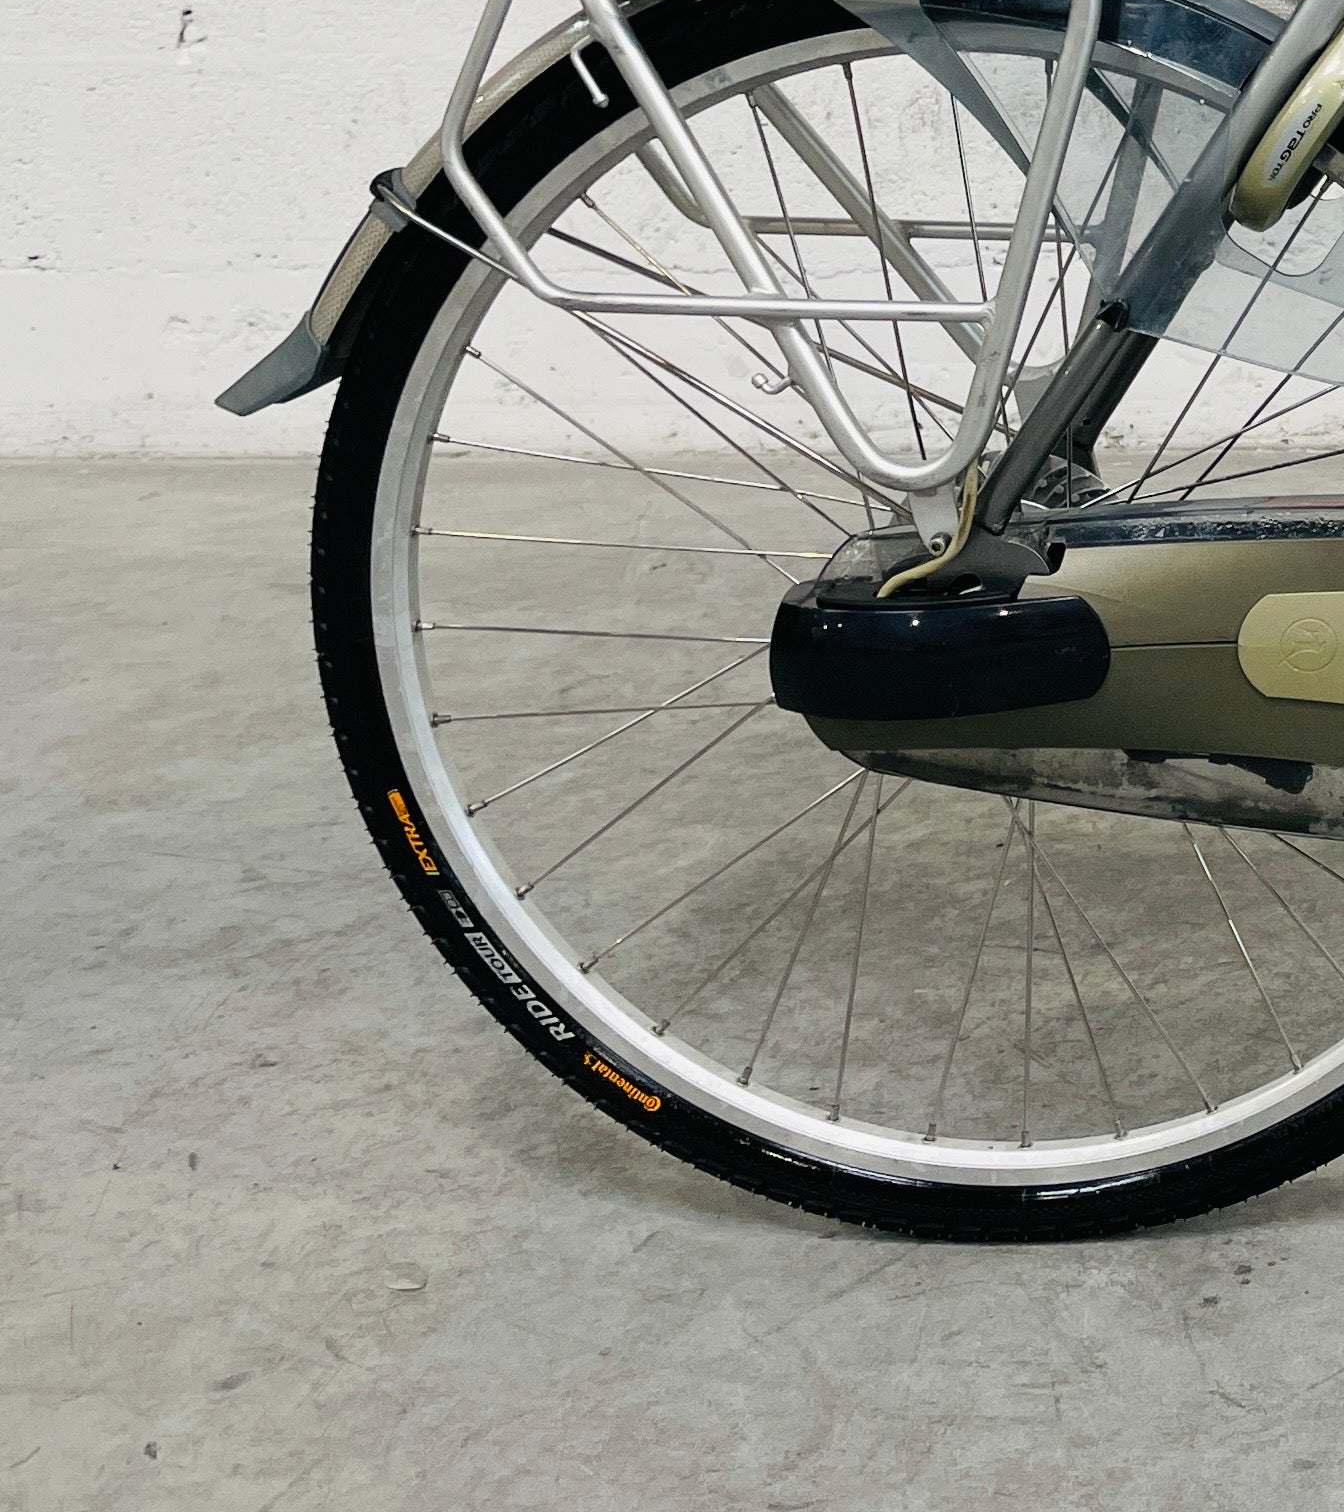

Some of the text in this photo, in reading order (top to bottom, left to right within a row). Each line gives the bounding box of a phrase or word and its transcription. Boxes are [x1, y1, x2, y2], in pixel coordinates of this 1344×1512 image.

[399, 813, 438, 872] EXTRA
[470, 935, 576, 1041] RIDE TOUR
[592, 1059, 662, 1112] Continental
